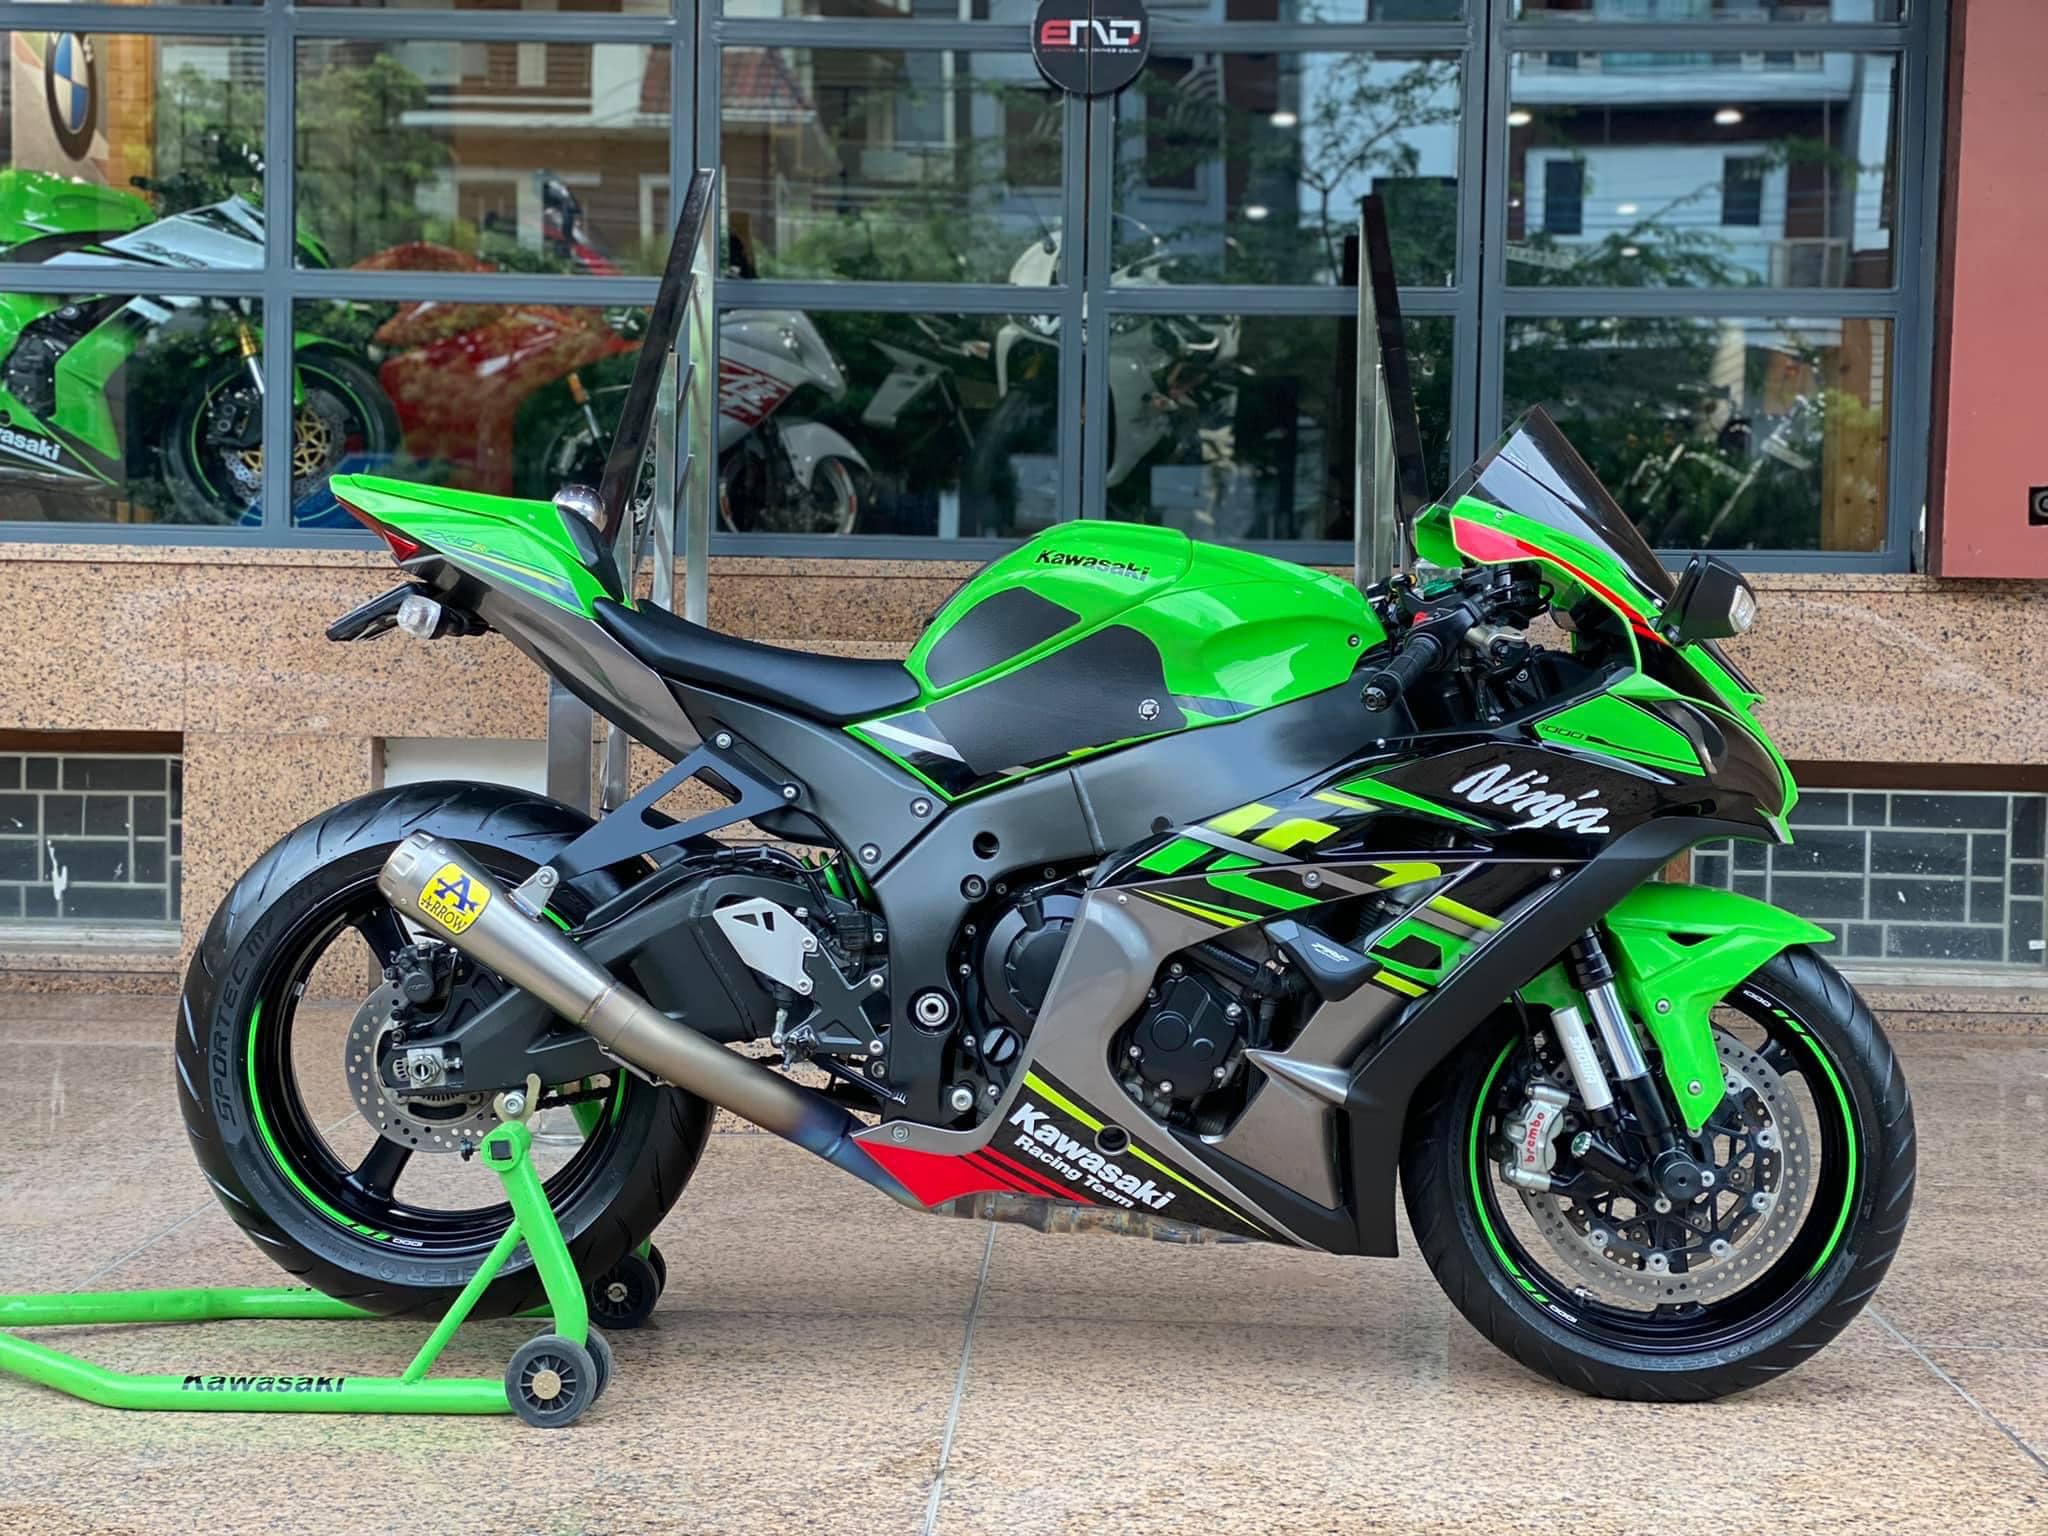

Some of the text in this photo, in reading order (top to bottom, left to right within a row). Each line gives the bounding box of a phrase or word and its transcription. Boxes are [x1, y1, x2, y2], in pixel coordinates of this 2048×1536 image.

[0, 428, 61, 461] asaki
[1035, 550, 1151, 582] Kawasaki
[1541, 723, 1585, 740] 1000
[1452, 763, 1610, 834] Ninja
[420, 895, 468, 931] ARROW
[1743, 990, 1772, 1008] 1000
[212, 959, 248, 1127] SPORTEC
[1525, 1111, 1545, 1164] brembo
[1009, 1102, 1176, 1210] Kawasaki
[1014, 1134, 1136, 1208] Racing Team
[181, 1375, 345, 1393] Kawasaki
